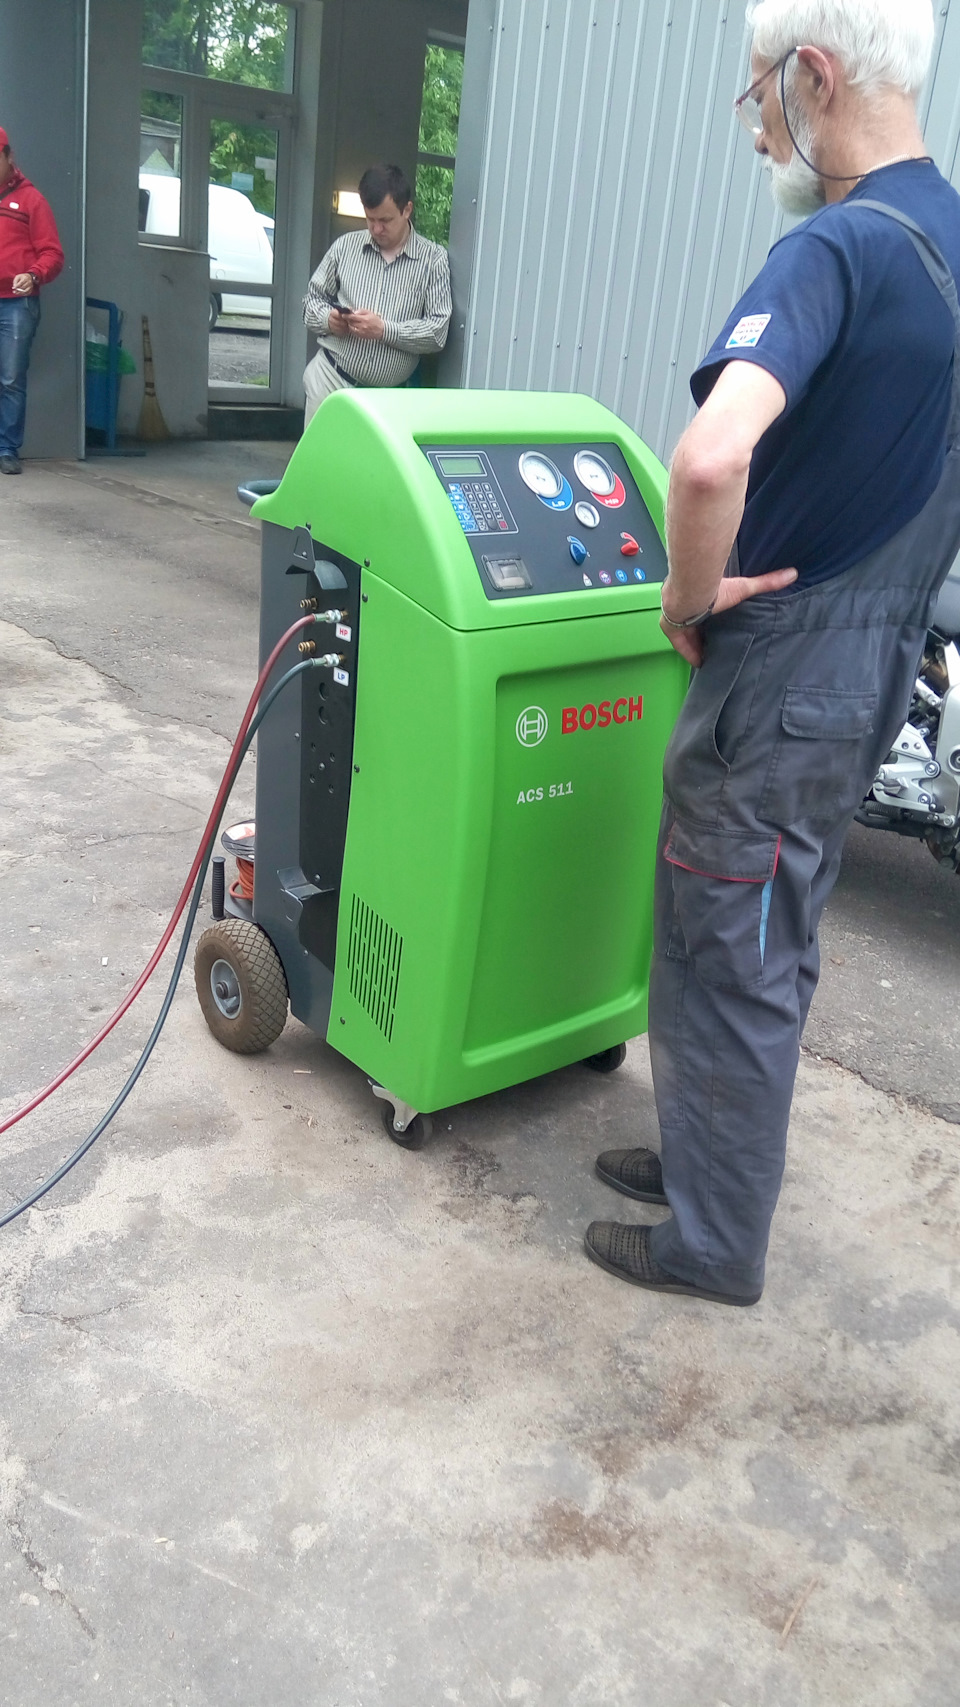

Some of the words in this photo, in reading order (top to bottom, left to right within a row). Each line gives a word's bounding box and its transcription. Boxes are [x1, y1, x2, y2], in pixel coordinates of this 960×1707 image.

[339, 628, 348, 636] HP
[338, 672, 345, 680] LP
[562, 694, 643, 734] BOSCH
[516, 787, 544, 804] ACS
[548, 781, 573, 798] 511
